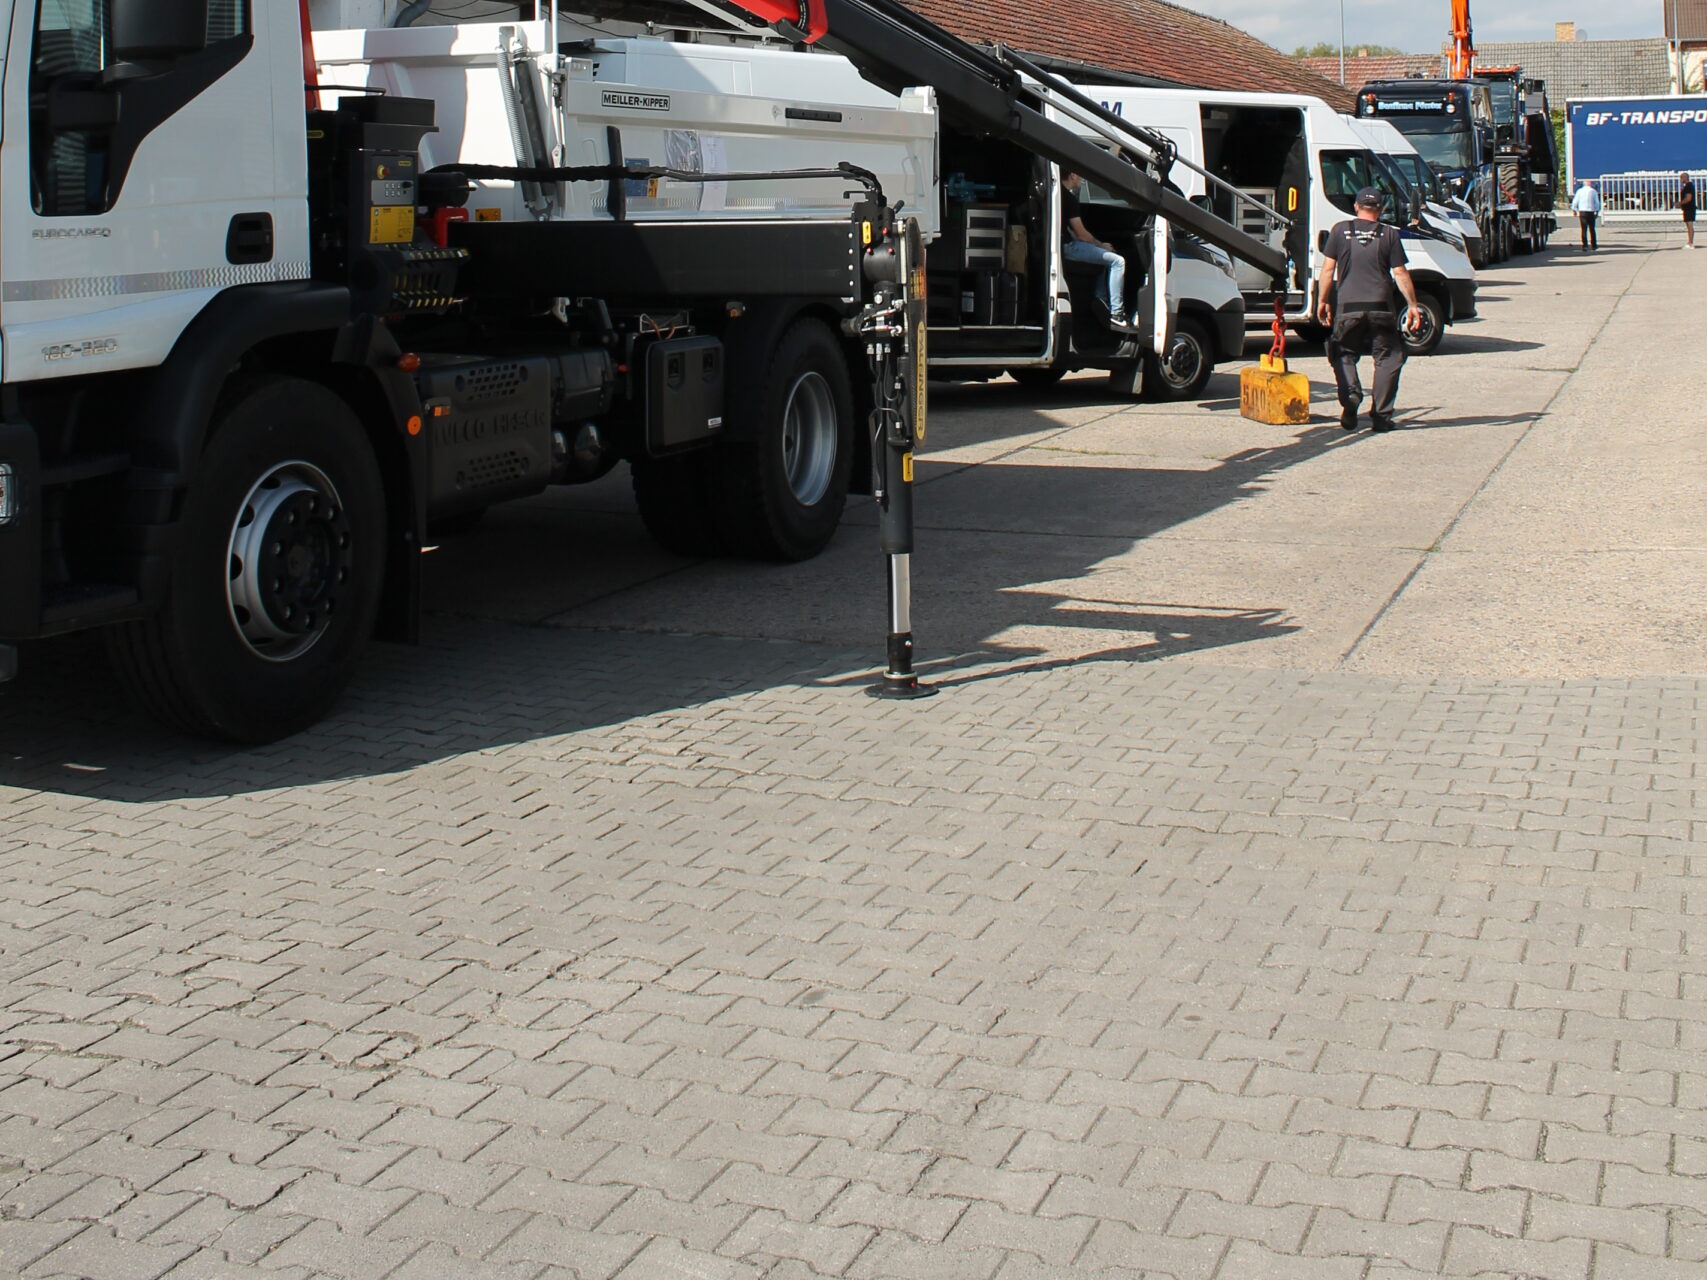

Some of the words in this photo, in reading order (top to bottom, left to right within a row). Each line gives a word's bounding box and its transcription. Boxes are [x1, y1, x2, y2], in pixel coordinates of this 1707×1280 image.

[603, 93, 669, 108] MEILLER-KIPPER
[1586, 109, 1707, 126] BF-TRANSPO
[31, 227, 112, 239] EUROCARGO
